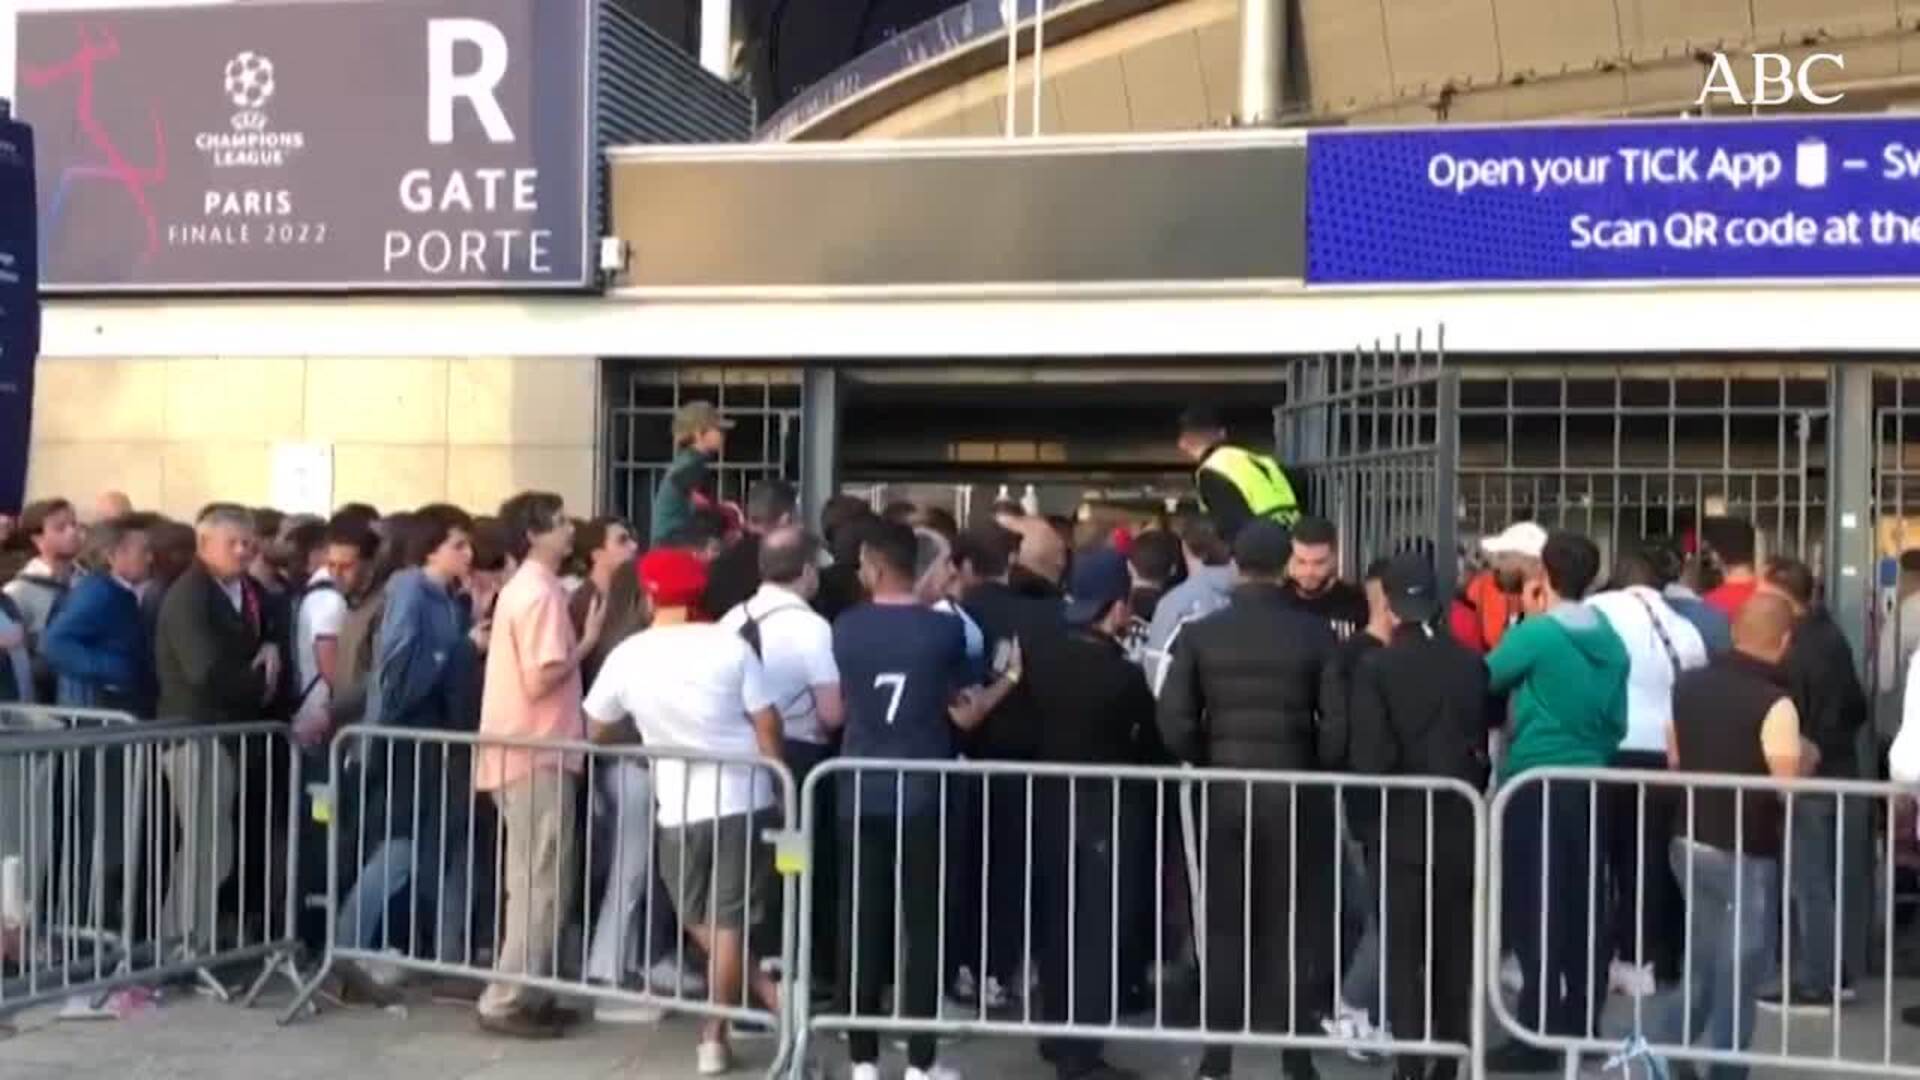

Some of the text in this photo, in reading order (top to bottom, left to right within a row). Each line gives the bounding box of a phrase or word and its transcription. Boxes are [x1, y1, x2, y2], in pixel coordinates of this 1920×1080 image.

[427, 17, 516, 144] R
[195, 132, 304, 149] CHAMPIONS
[214, 150, 283, 167] LEAGUE
[1428, 153, 1525, 194] Open
[1531, 155, 1611, 192] your
[1617, 147, 1699, 183] TICK
[1706, 146, 1782, 190] App
[204, 190, 291, 215] PARIS
[400, 168, 539, 213] GATE
[168, 224, 327, 245] FINALE 2022
[1570, 214, 1657, 248] Scan
[1663, 211, 1718, 248] QR
[1725, 211, 1818, 246] code
[1823, 211, 1862, 245] at
[384, 229, 552, 273] PORTE
[874, 674, 906, 724] 7
